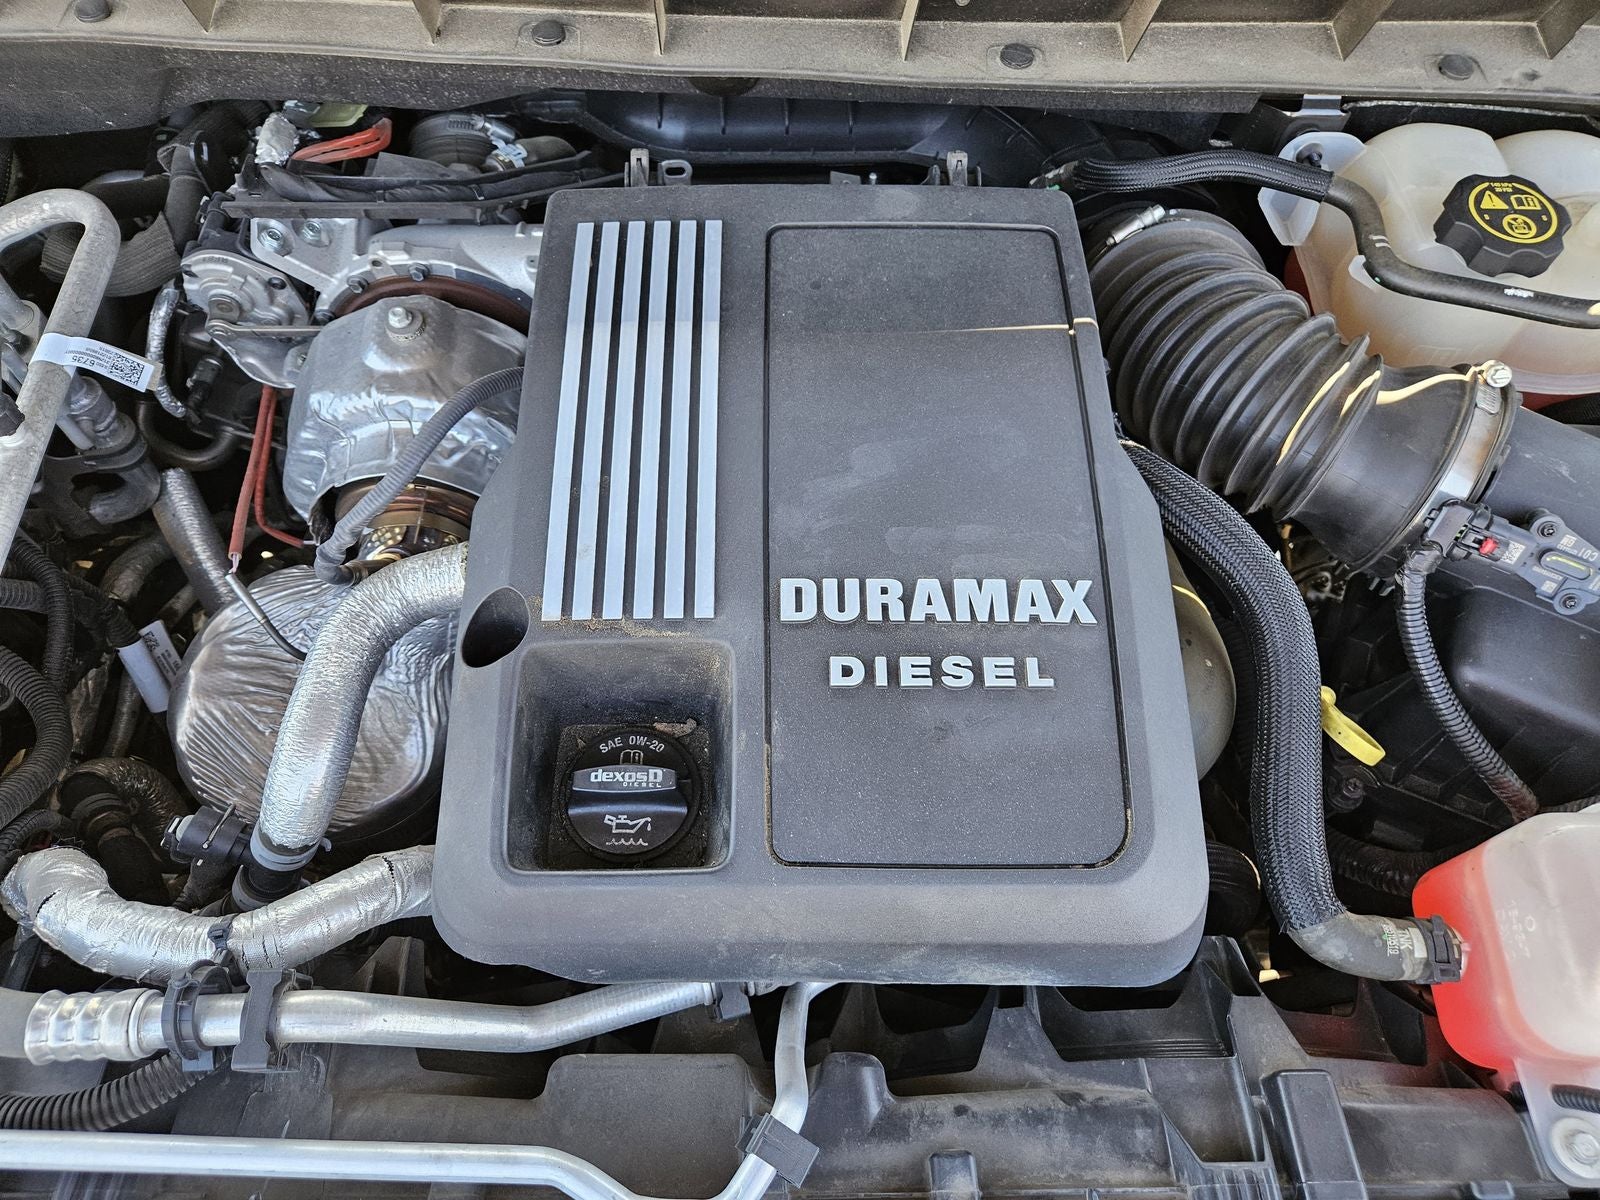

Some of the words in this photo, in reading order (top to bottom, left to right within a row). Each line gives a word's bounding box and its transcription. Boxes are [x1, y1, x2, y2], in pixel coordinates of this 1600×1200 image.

[780, 578, 1098, 625] DURAMAX
[829, 655, 1055, 690] DIESEL
[599, 737, 623, 753] SAE
[628, 735, 665, 753] 0W-20
